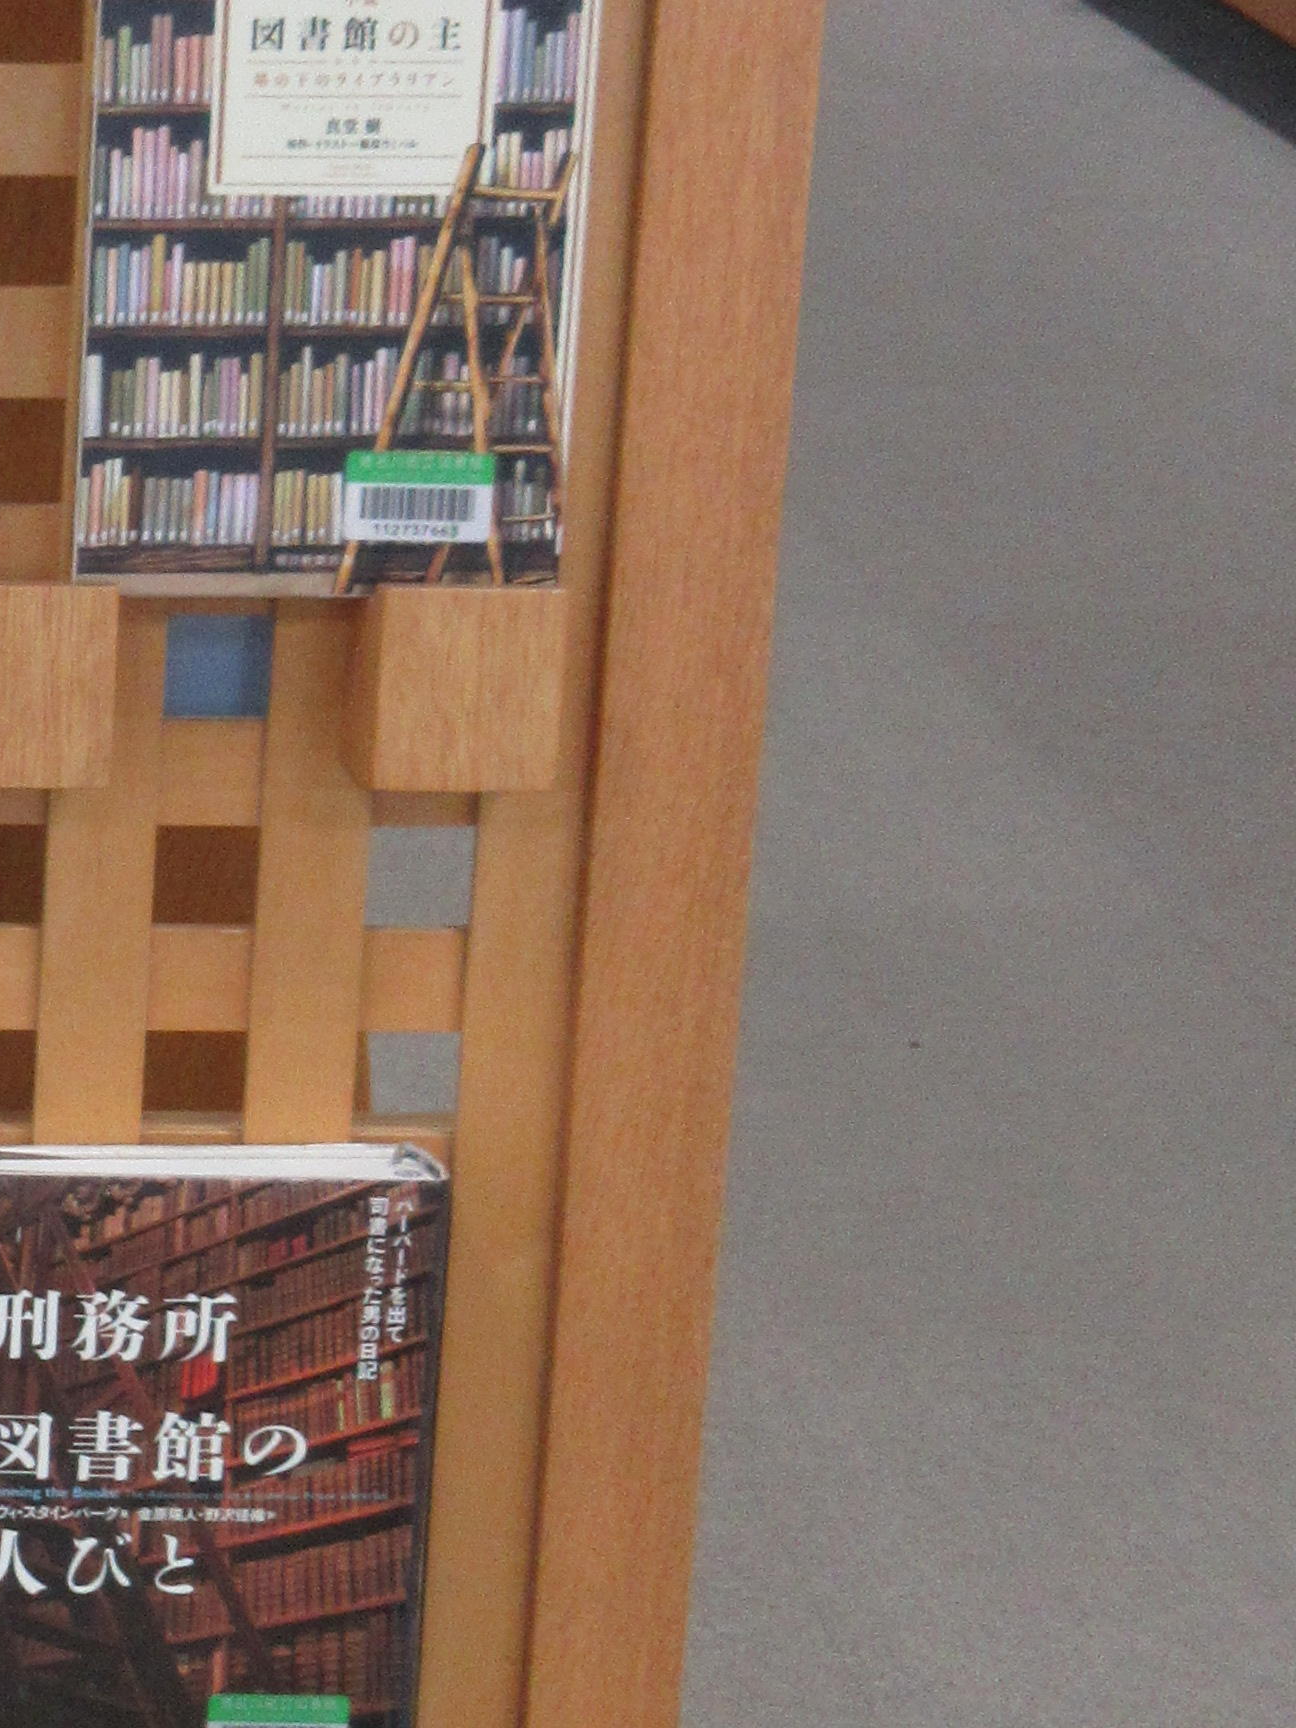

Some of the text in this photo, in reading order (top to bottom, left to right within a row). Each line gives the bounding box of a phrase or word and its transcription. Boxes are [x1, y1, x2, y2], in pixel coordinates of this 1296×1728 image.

[250, 16, 462, 52] 図書館の主
